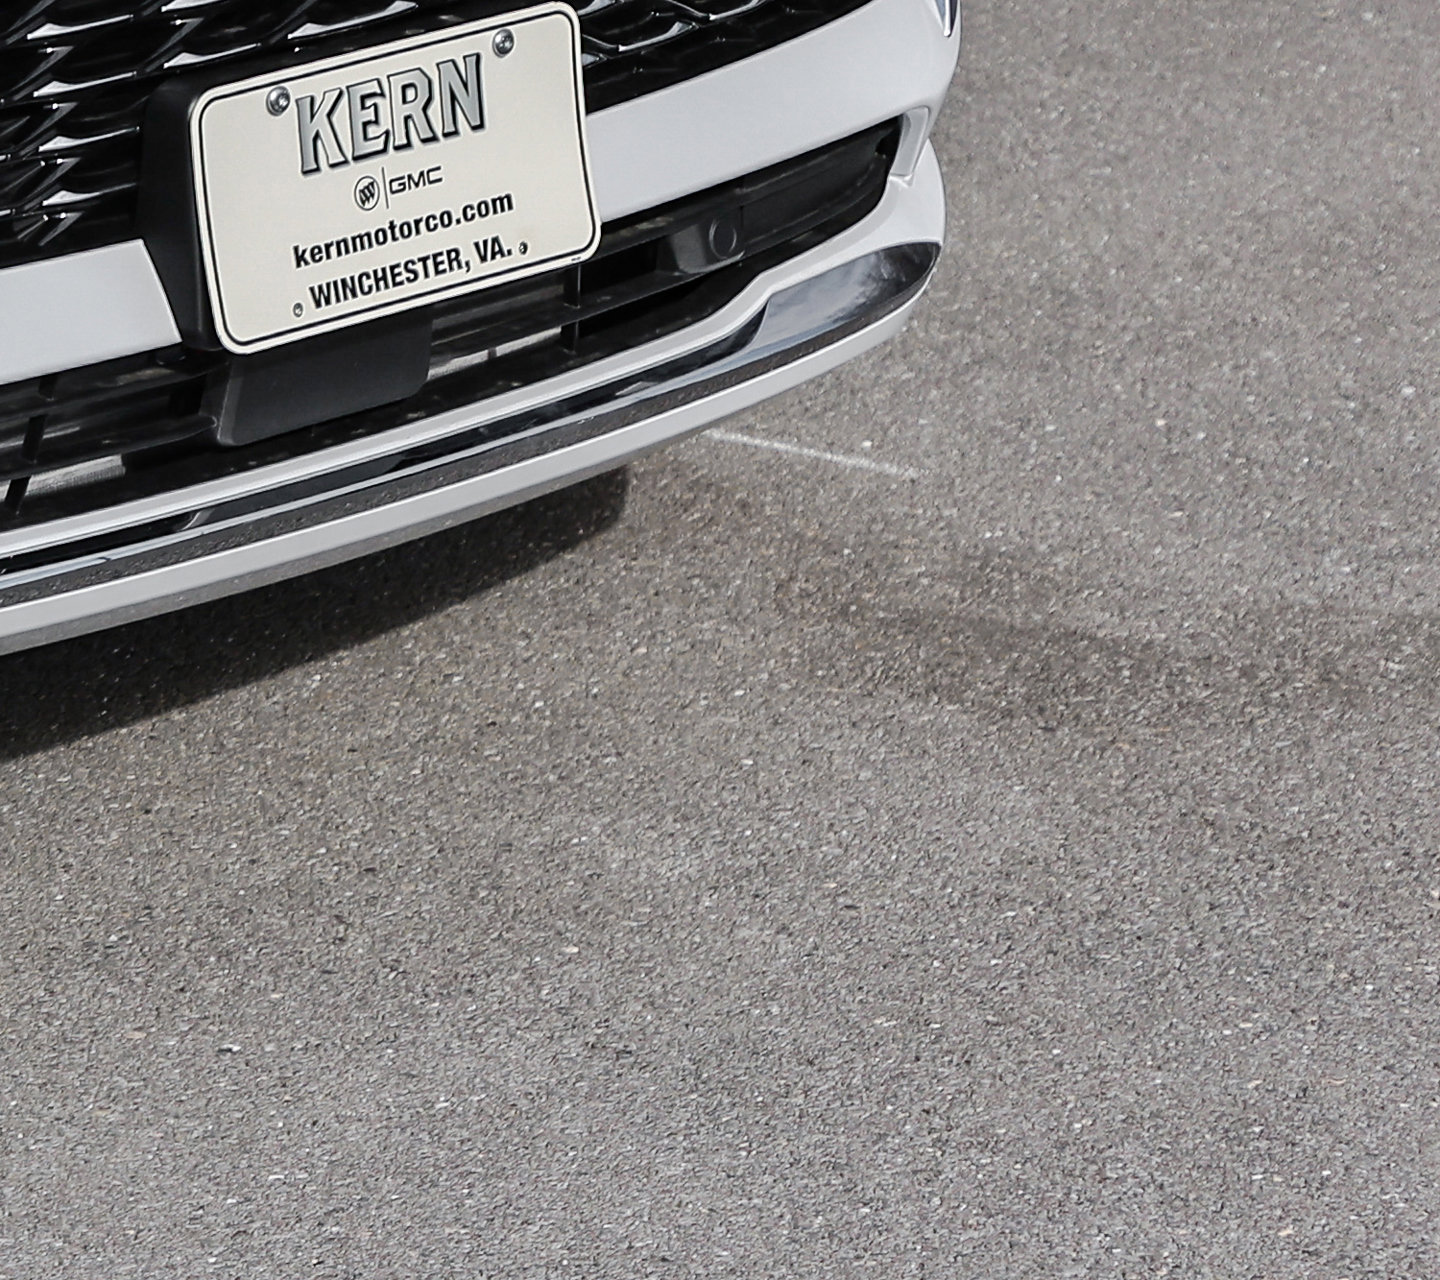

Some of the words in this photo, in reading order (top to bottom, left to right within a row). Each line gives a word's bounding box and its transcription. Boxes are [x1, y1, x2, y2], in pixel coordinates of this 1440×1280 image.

[295, 52, 485, 175] KERN
[388, 166, 443, 195] GMC
[293, 192, 514, 268] kernmotorco.com
[309, 251, 471, 310] WINCHESTER,
[473, 236, 513, 265] VA.
